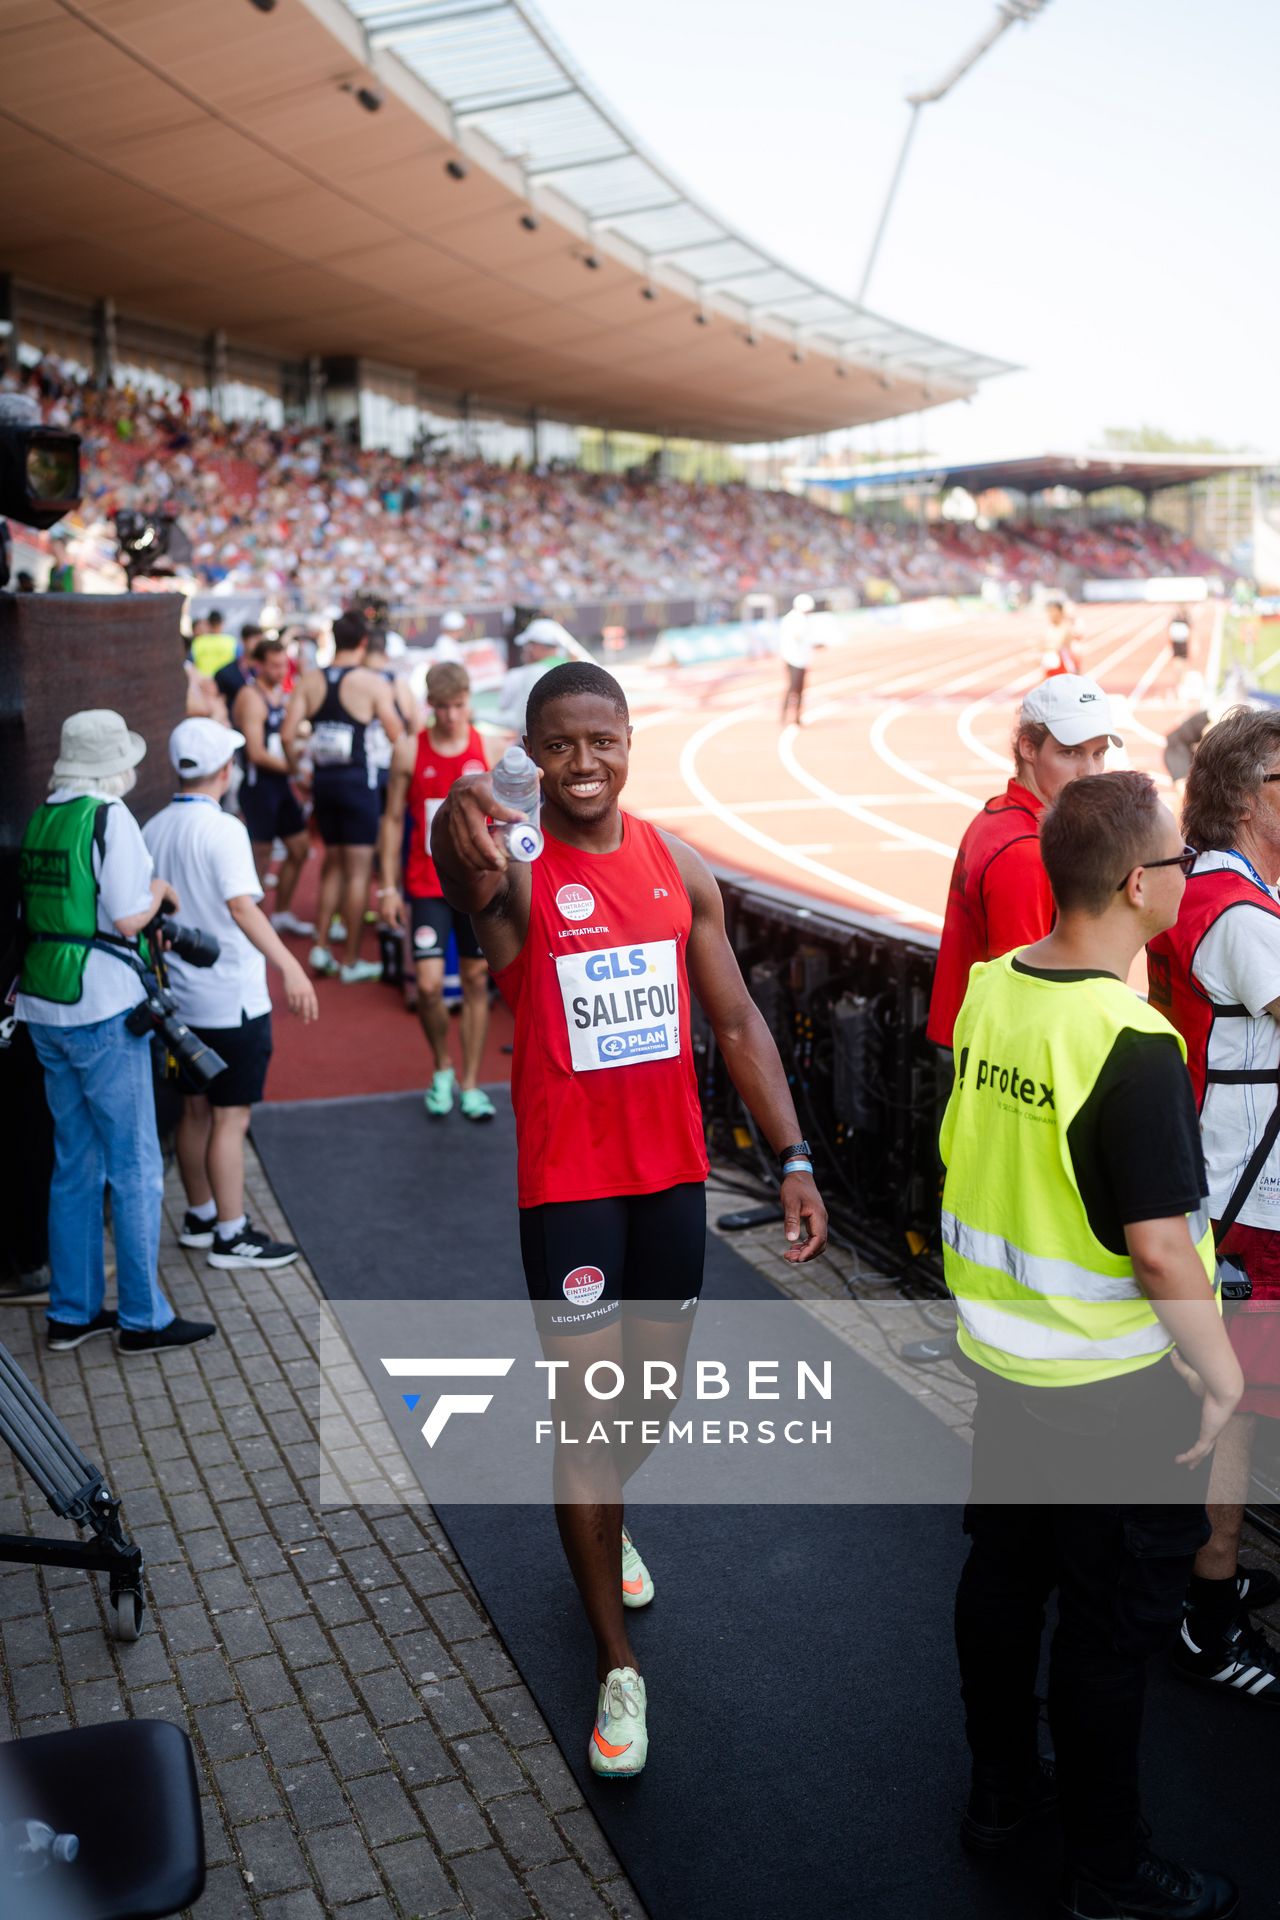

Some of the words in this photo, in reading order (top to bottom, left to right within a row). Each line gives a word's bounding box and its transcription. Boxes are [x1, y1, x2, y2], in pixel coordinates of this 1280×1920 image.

[558, 926, 610, 938] LEICHTATHLETIK
[572, 983, 676, 1029] SALIFOU
[628, 1031, 665, 1048] PLAN
[976, 1060, 1055, 1110] protex
[575, 1274, 594, 1285] VfL
[566, 1283, 603, 1296] EINTRACHT
